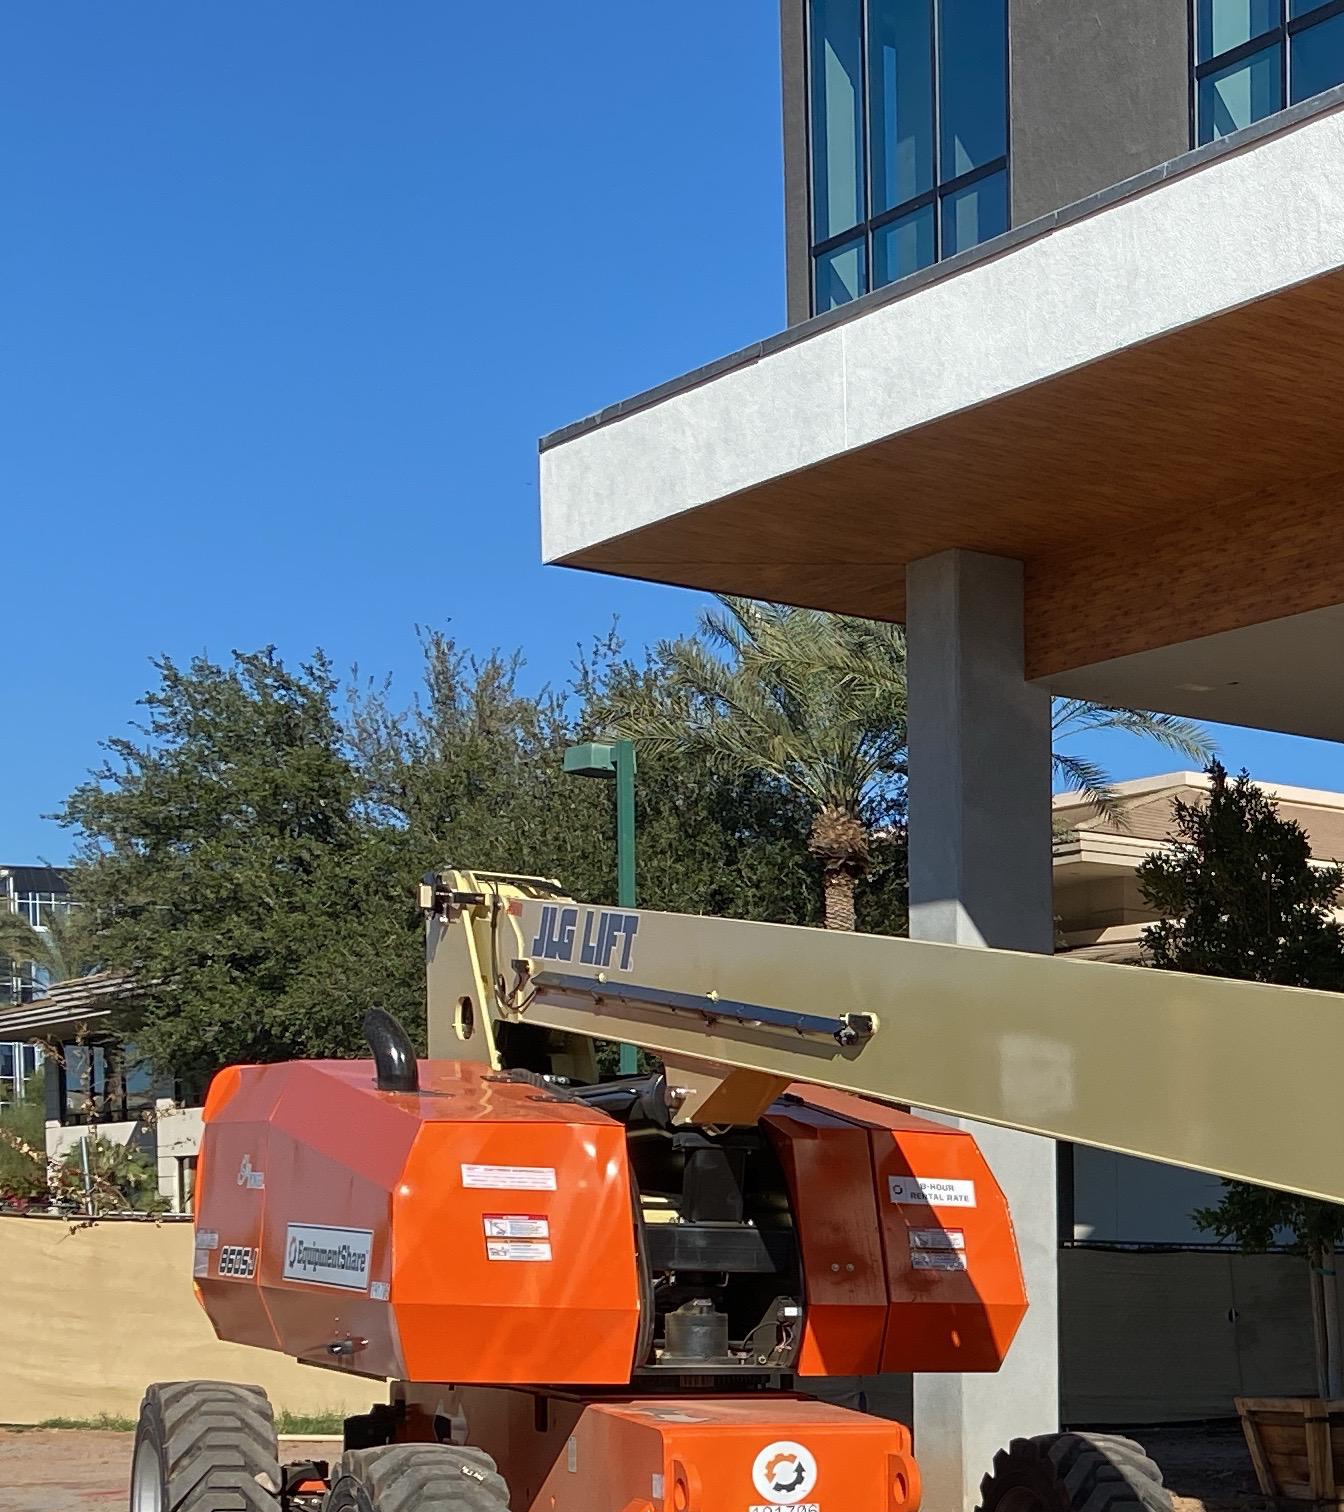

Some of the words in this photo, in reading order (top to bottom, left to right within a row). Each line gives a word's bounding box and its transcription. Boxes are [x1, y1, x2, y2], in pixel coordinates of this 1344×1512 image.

[531, 903, 580, 963] JLG
[579, 908, 641, 972] LIFT
[946, 1193, 970, 1203] RATE
[298, 1239, 367, 1273] EquipmentShare
